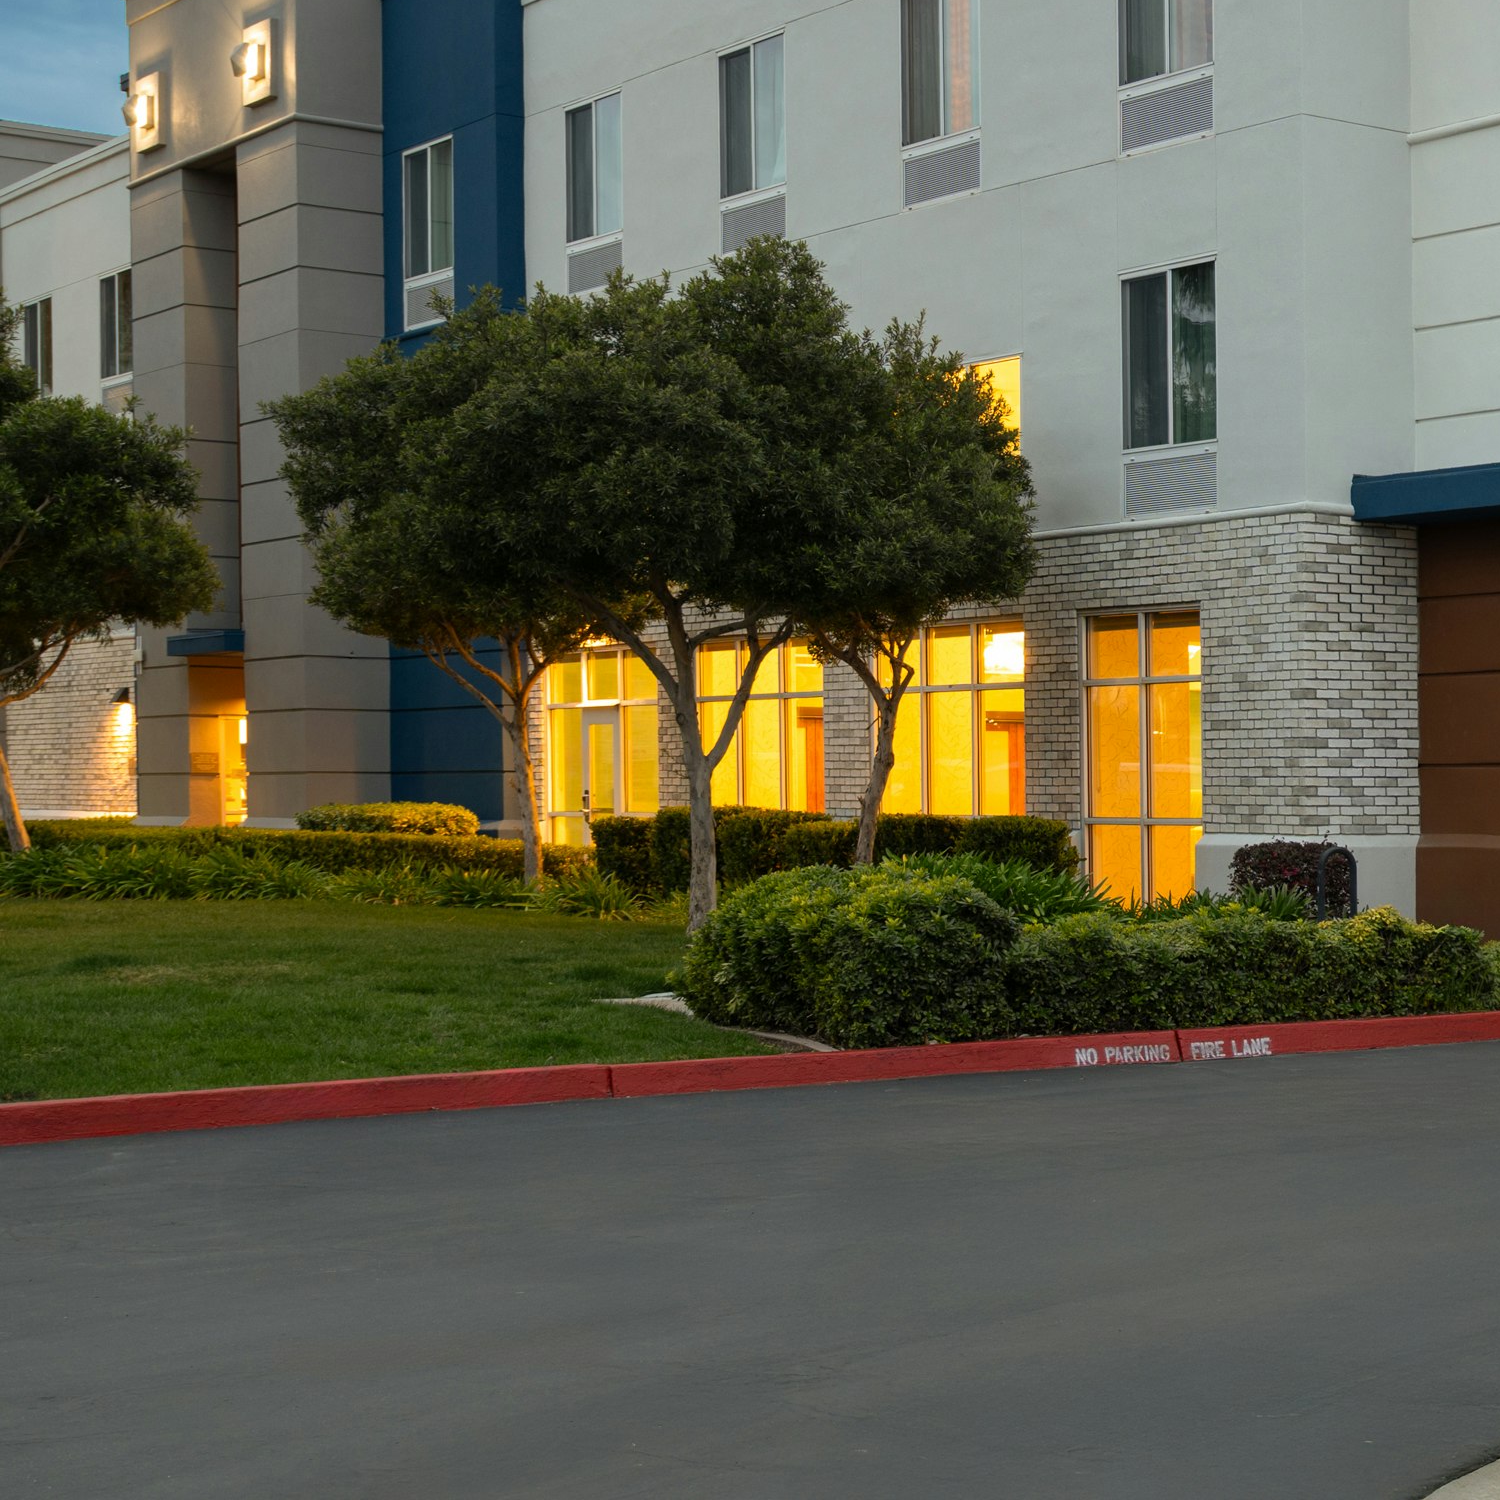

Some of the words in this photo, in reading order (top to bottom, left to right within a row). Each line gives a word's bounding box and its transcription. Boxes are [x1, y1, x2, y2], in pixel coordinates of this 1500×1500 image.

[1074, 1047, 1099, 1066] NO
[1105, 1044, 1170, 1064] PARKING
[1190, 1040, 1227, 1060] FIRE
[1231, 1036, 1272, 1056] LANE
